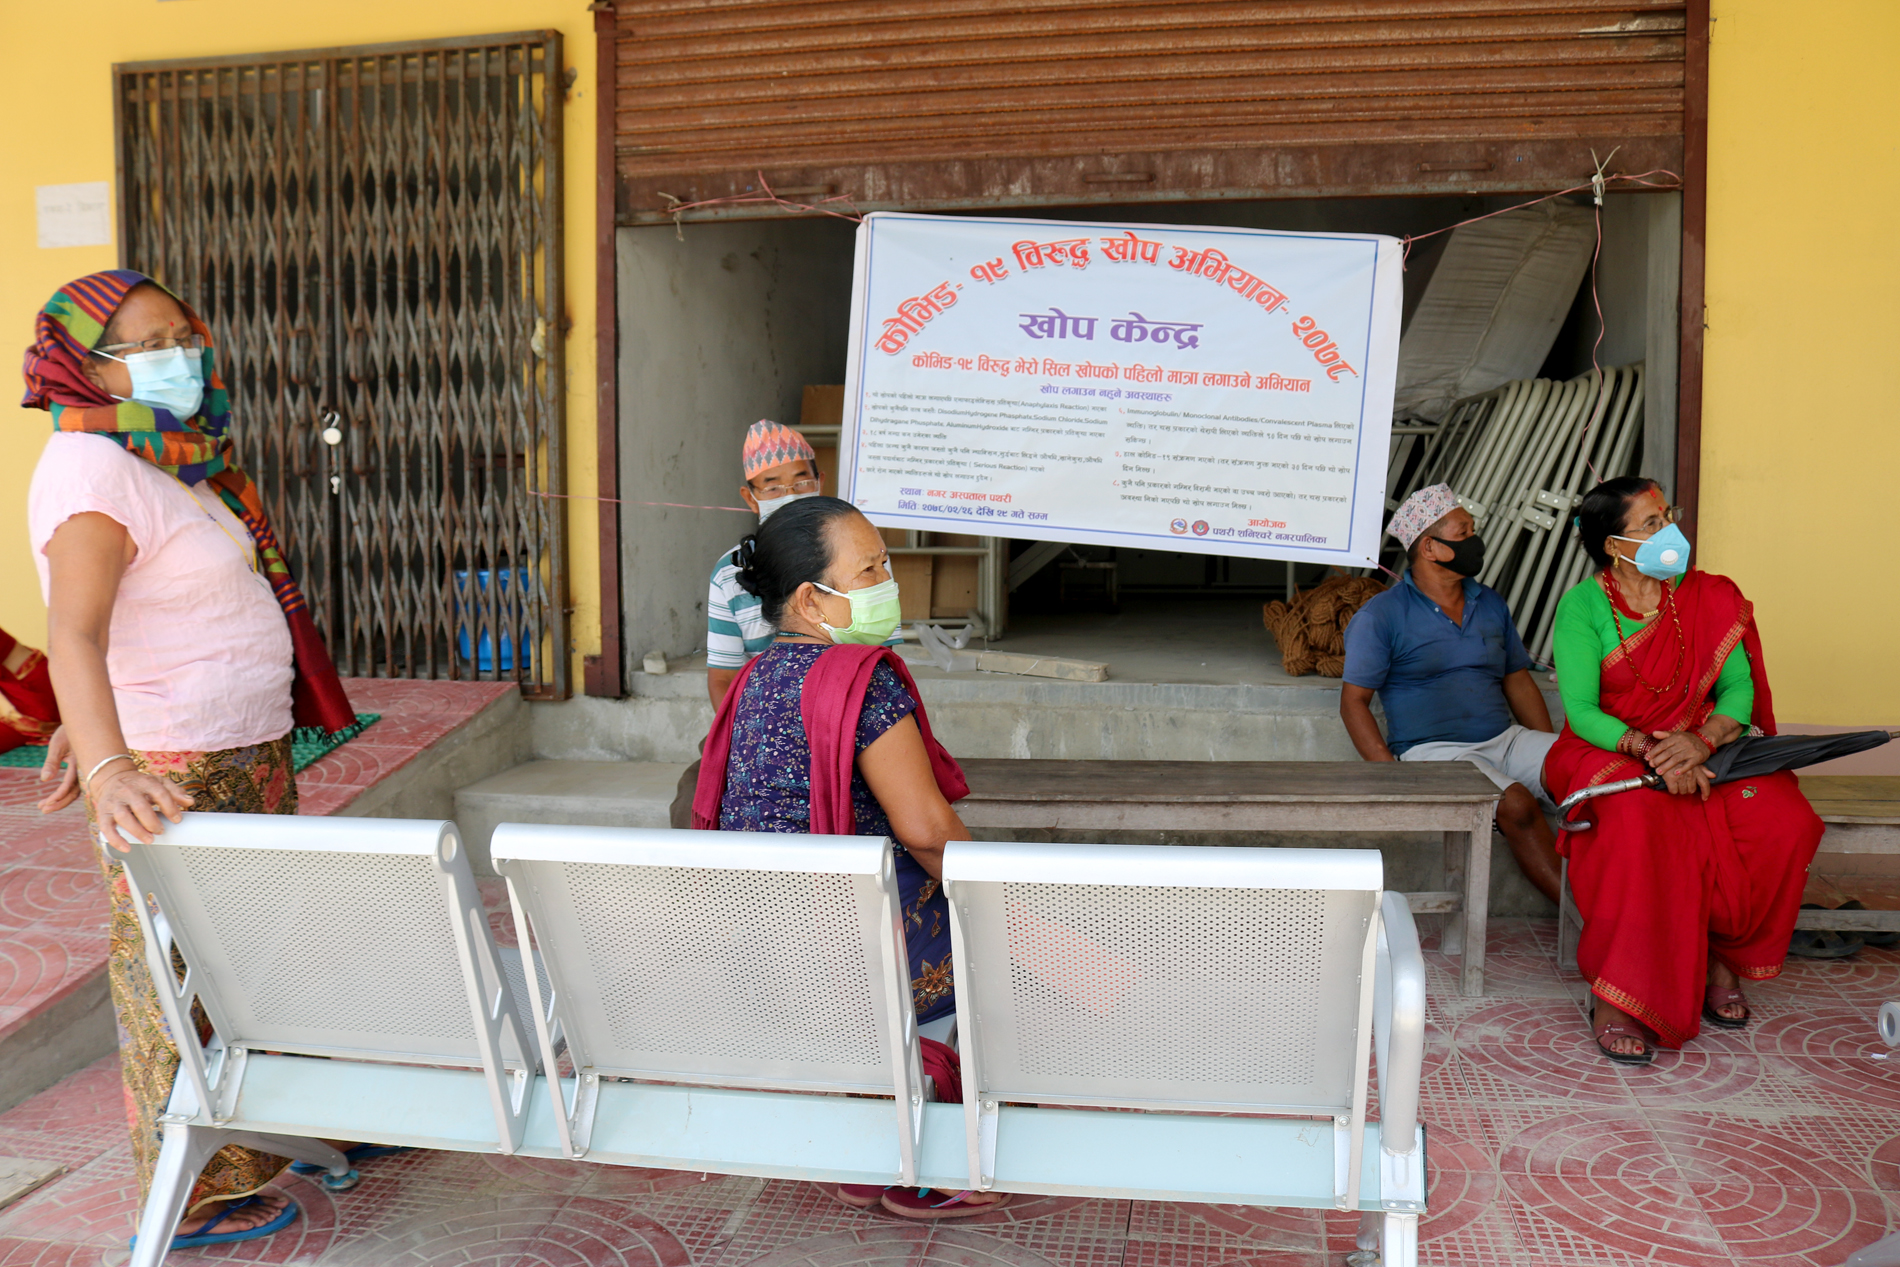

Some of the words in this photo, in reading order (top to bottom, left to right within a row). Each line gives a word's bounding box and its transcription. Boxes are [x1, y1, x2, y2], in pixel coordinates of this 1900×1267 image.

[970, 257, 1009, 284] १९
[1100, 231, 1163, 263] खोप
[1292, 315, 1358, 381] २०७८
[1019, 307, 1098, 340] खोप
[1110, 312, 1204, 350] केन्द्र
[912, 351, 973, 371] कोभिड-१९
[1014, 356, 1039, 376] भेरो
[1042, 358, 1071, 378] सिल
[1074, 360, 1119, 380] खोपको
[1123, 363, 1163, 383] पहिलो
[1167, 370, 1199, 386] मात्रा
[1203, 371, 1252, 389] लगाउने
[1255, 372, 1311, 393] अभियान
[1039, 383, 1060, 395] खोप
[1062, 386, 1097, 397] लगाउन
[1099, 388, 1121, 400] नहुने
[1183, 412, 1221, 420] Monoclonal
[1307, 420, 1333, 428] Plasma
[973, 461, 996, 469] Serious
[998, 464, 1027, 472] Reaction)
[927, 490, 946, 498] नगर
[950, 491, 987, 501] अस्पताल
[989, 493, 1012, 503] पथरी
[922, 504, 973, 516] २०७८/०२/२६
[976, 506, 994, 517] देखि
[997, 509, 1008, 517] २९
[1010, 509, 1024, 519] गते
[1028, 512, 1048, 521] सम्म
[1247, 518, 1288, 530] आयोजक
[1212, 527, 1234, 537] पथरी
[1275, 532, 1327, 545] नगरपालिका
